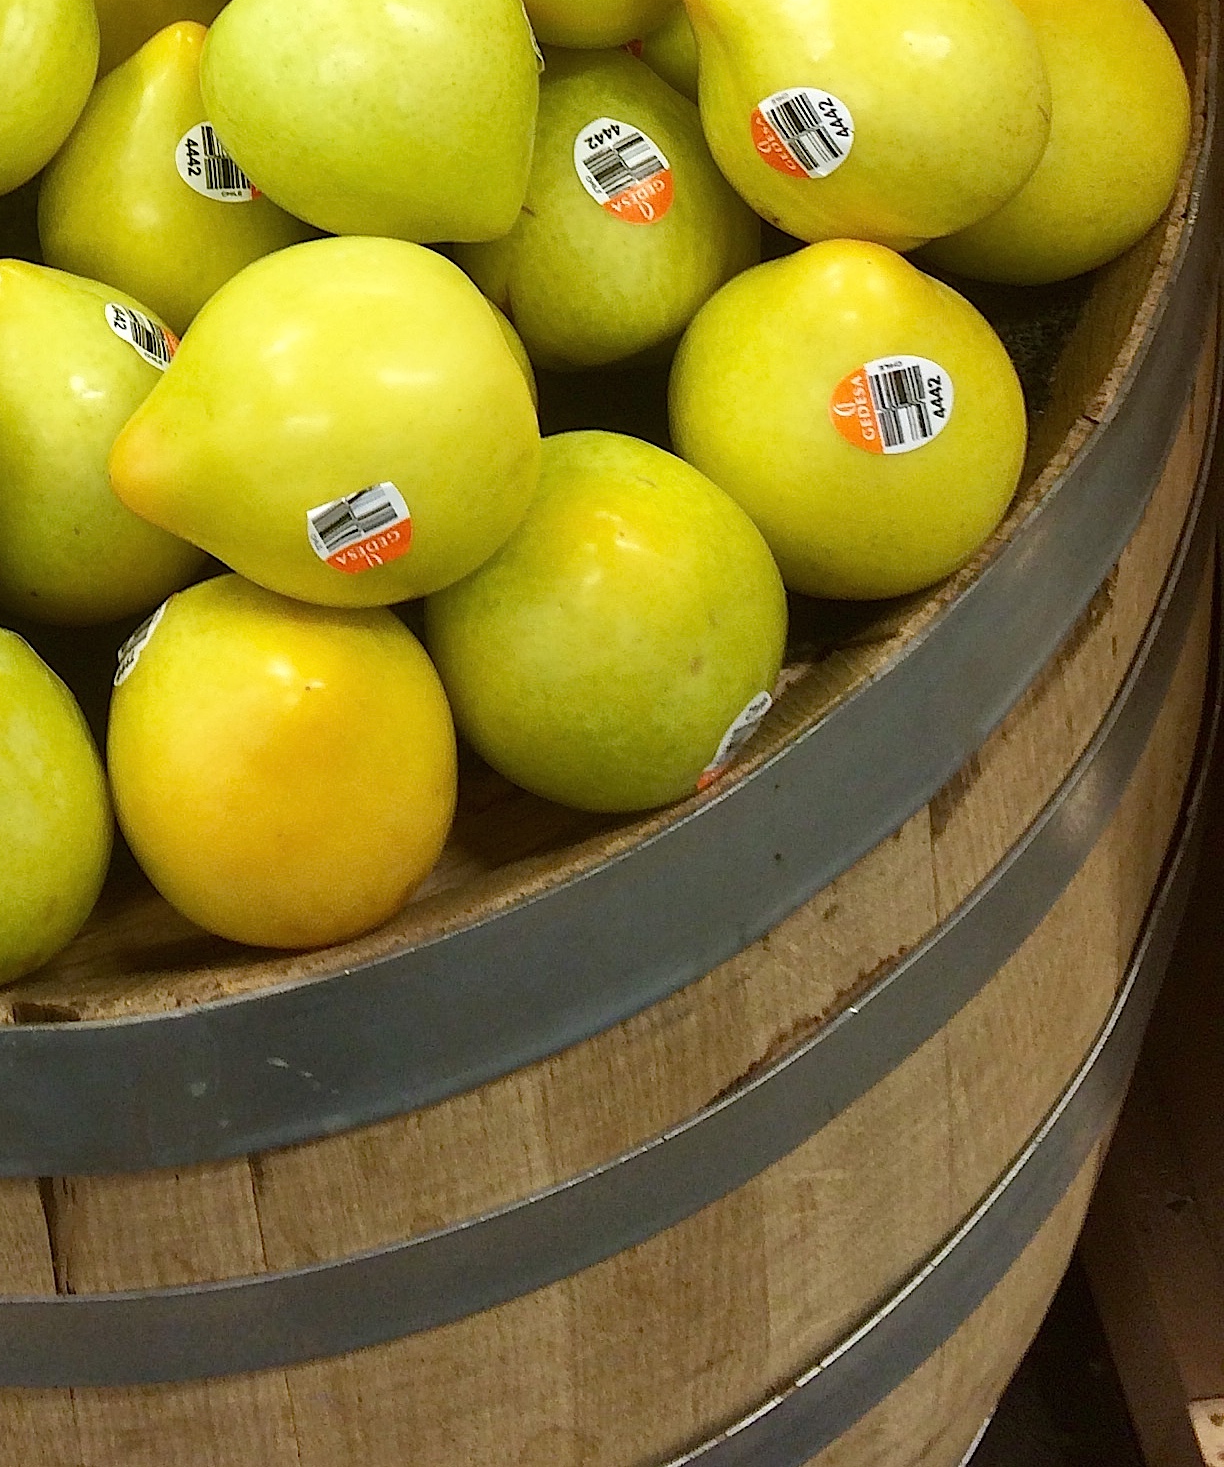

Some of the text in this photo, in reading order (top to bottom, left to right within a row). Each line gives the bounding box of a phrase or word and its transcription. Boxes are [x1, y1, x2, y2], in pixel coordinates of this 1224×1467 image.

[584, 124, 621, 151] 4442
[818, 97, 850, 138] 4442
[184, 138, 203, 178] 4442
[755, 116, 797, 172] GEDESA
[610, 178, 666, 213] GEDESA
[850, 375, 877, 442] GEDESA
[927, 374, 948, 420] 4442
[334, 529, 402, 567] GEDESA
